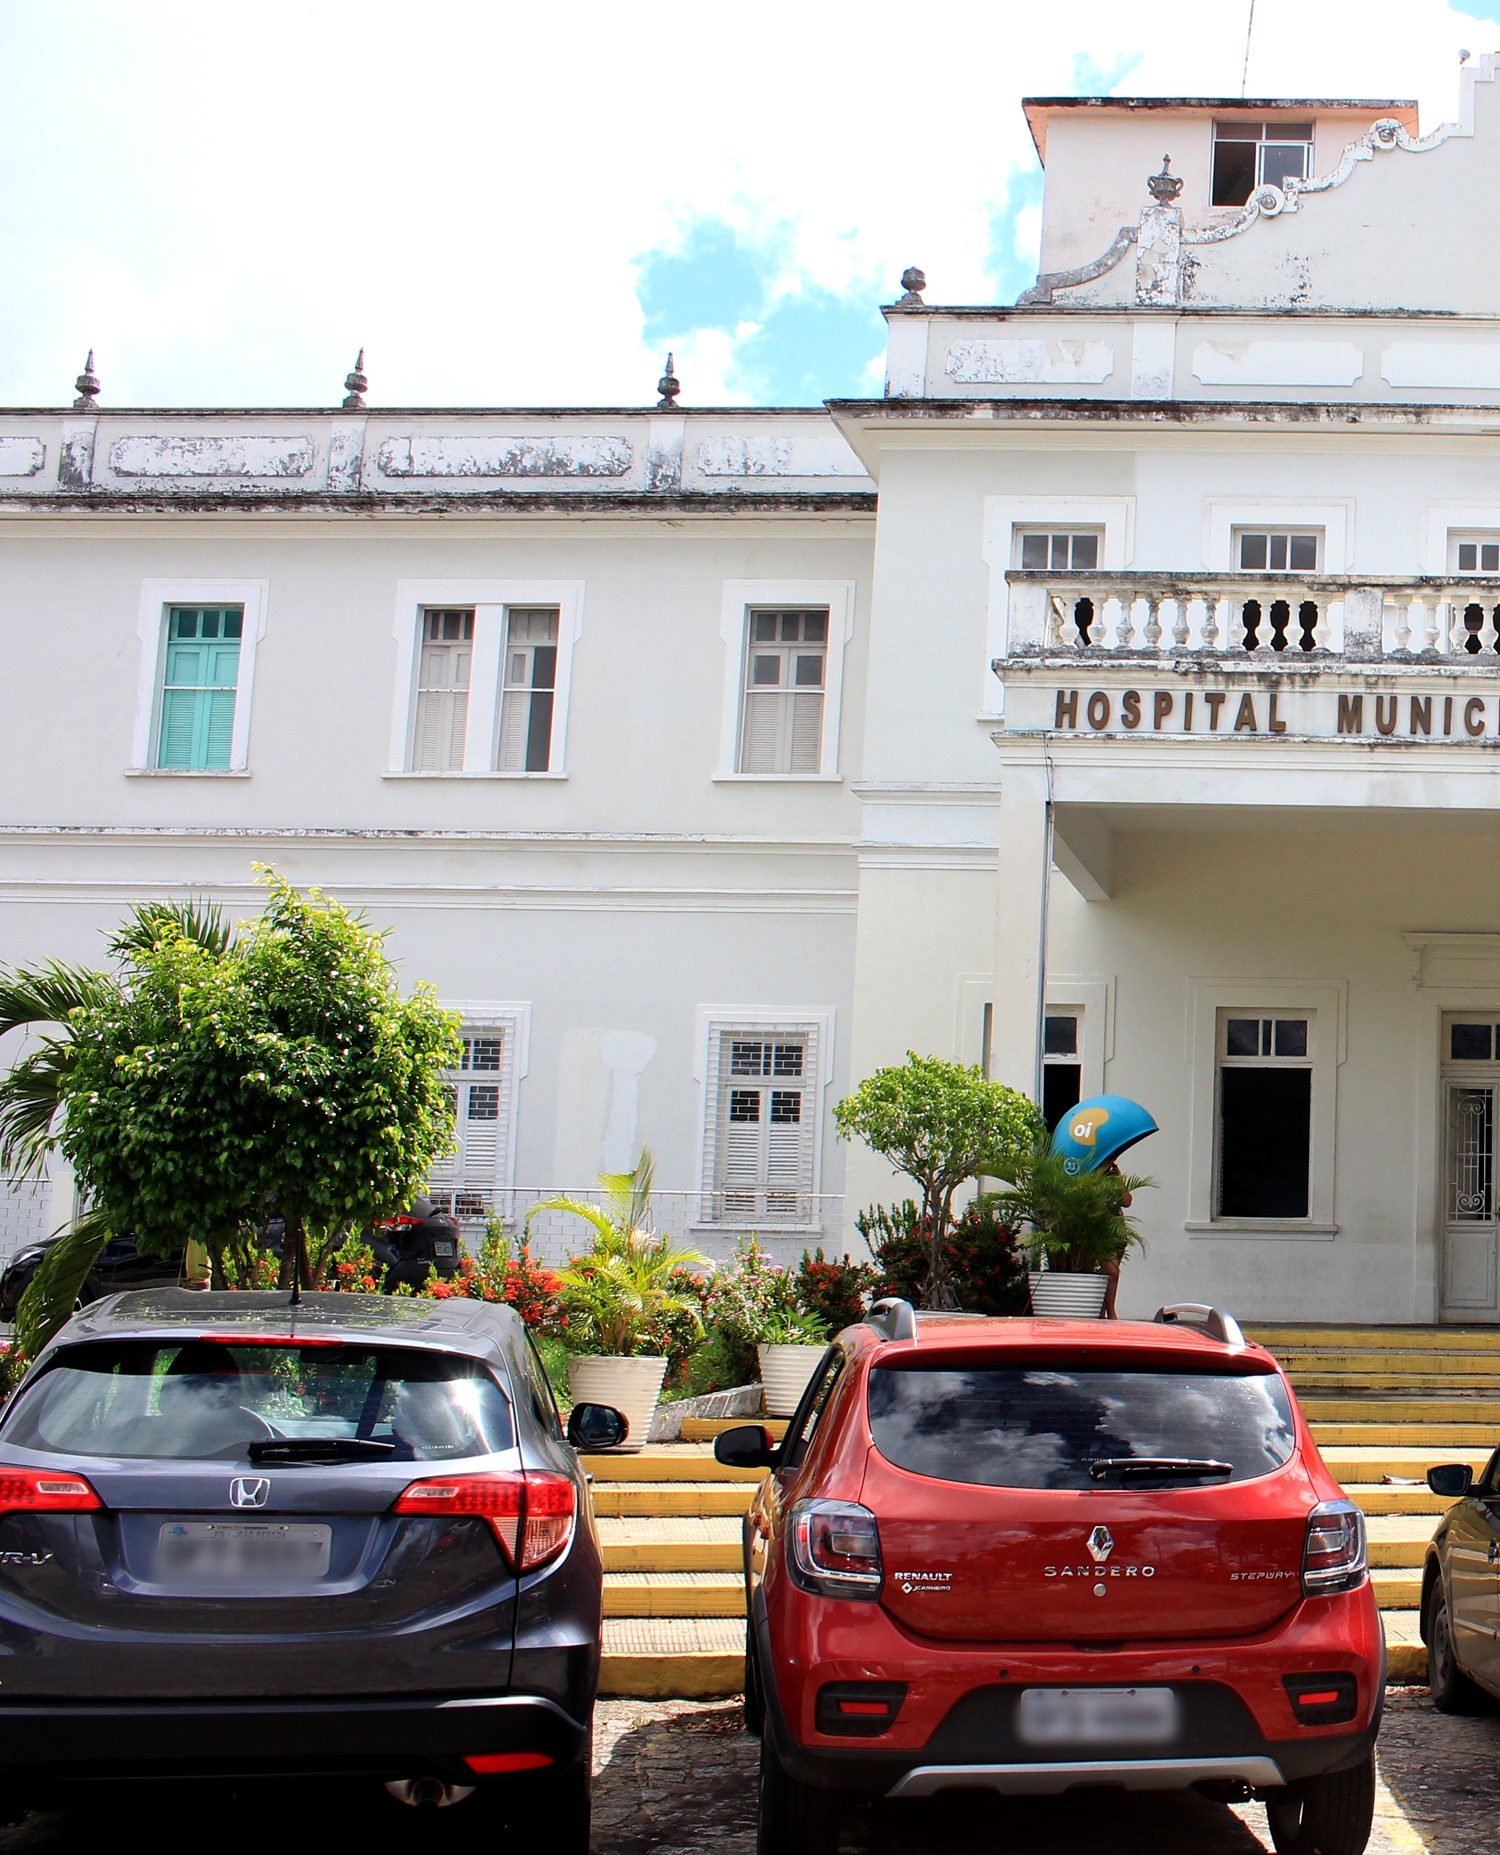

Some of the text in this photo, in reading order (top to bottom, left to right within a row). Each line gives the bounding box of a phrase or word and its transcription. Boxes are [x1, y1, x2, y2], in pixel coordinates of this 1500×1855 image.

[1054, 689, 1288, 733] HOSPITAL
[1074, 1121, 1093, 1138] oi
[0, 1551, 53, 1565] R-V
[894, 1571, 953, 1581] RENAULT
[1043, 1565, 1156, 1577] SANDERO
[1229, 1571, 1292, 1581] STEPWAY
